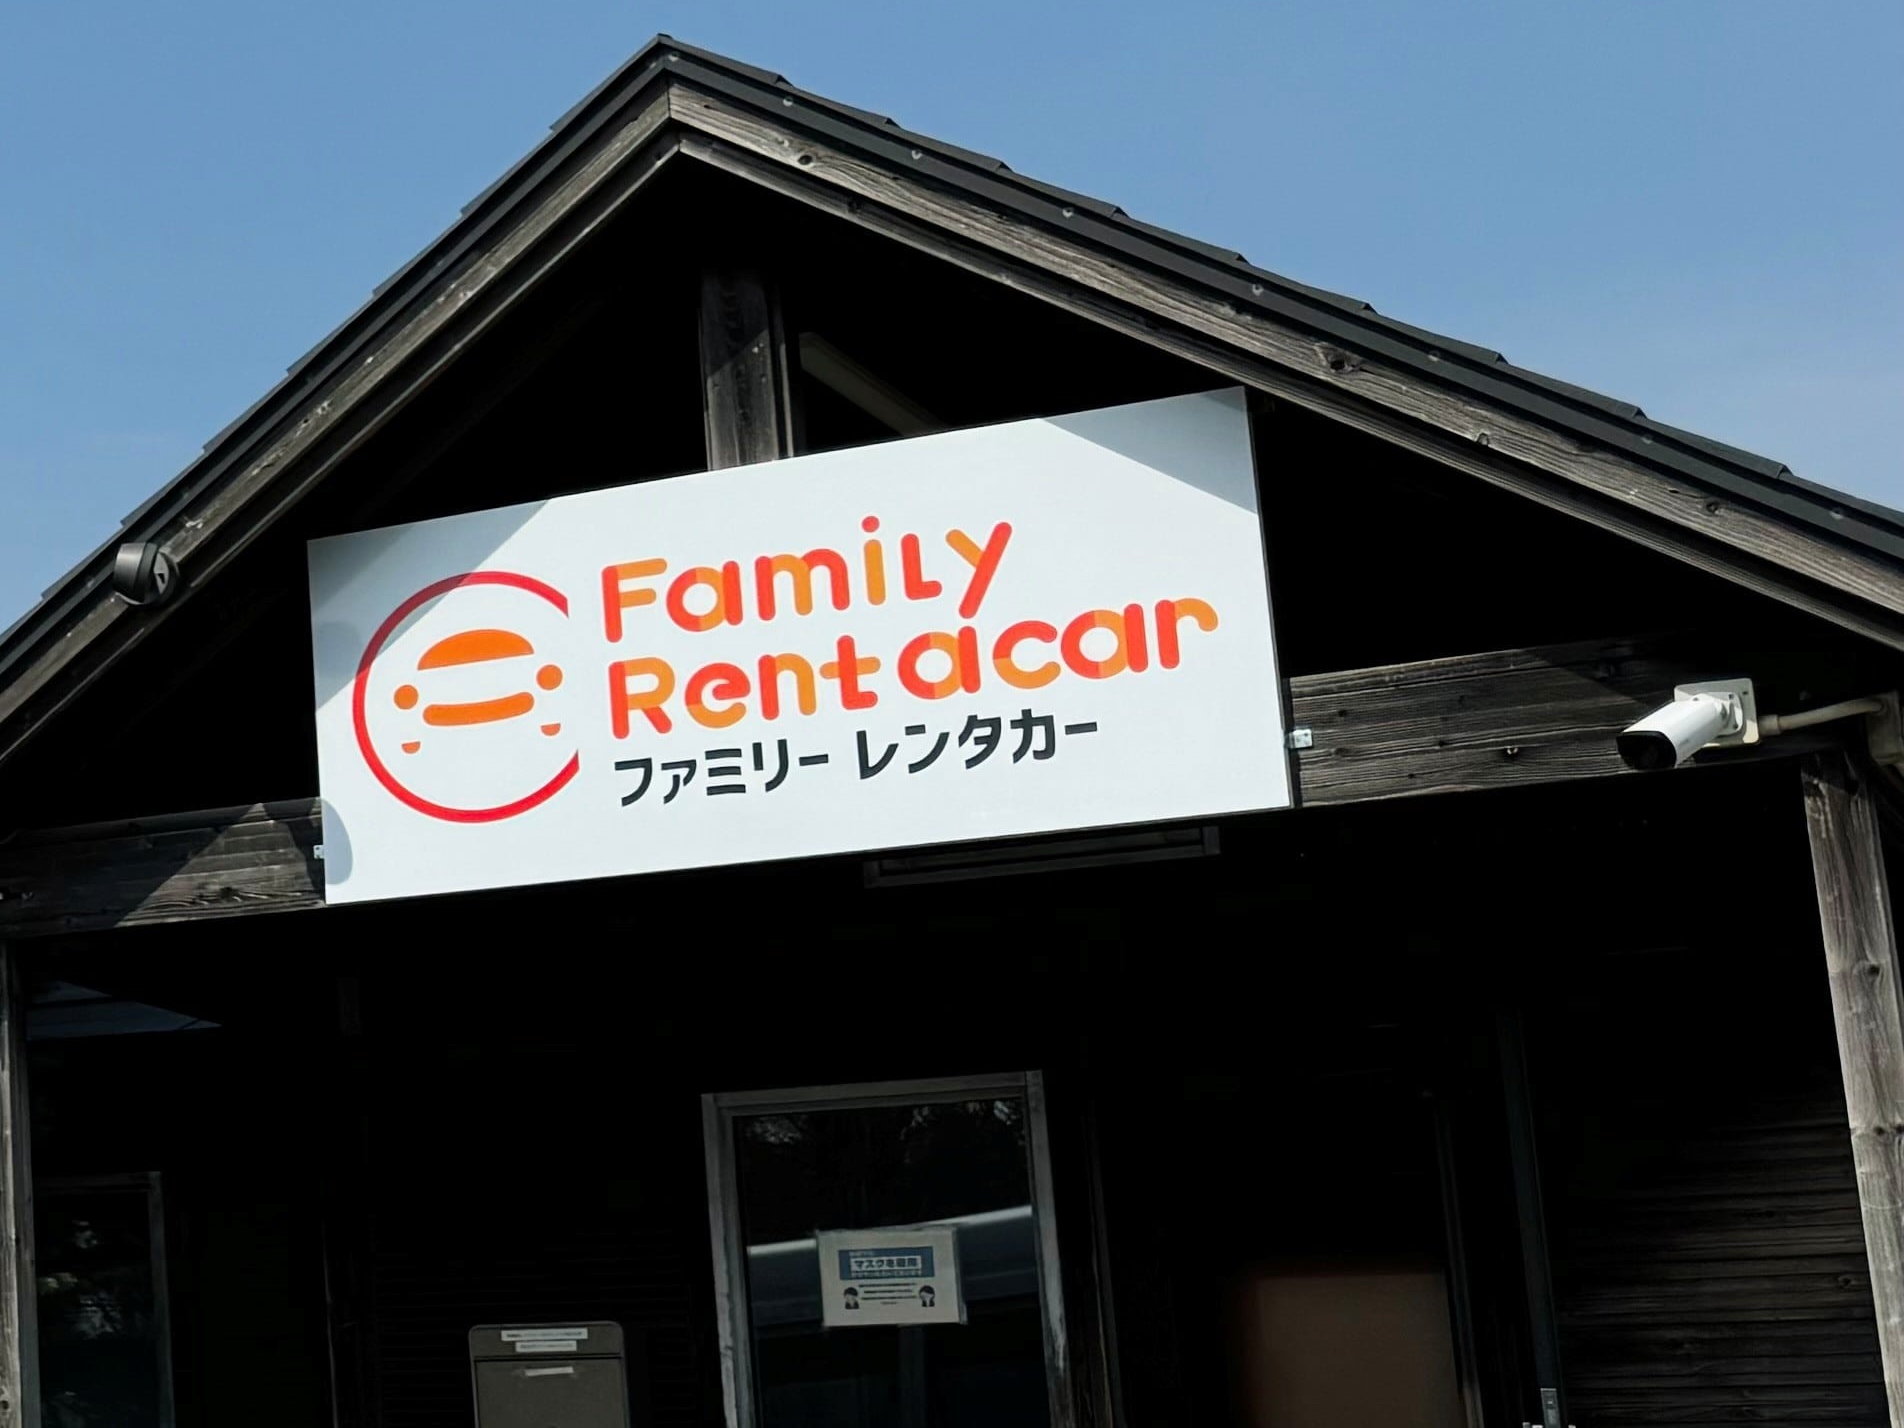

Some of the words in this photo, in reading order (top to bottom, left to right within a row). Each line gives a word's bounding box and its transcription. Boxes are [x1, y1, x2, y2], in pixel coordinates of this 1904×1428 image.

[603, 515, 1012, 642] Family
[614, 738, 829, 807] ファミリー
[856, 708, 1098, 780] レンタカー
